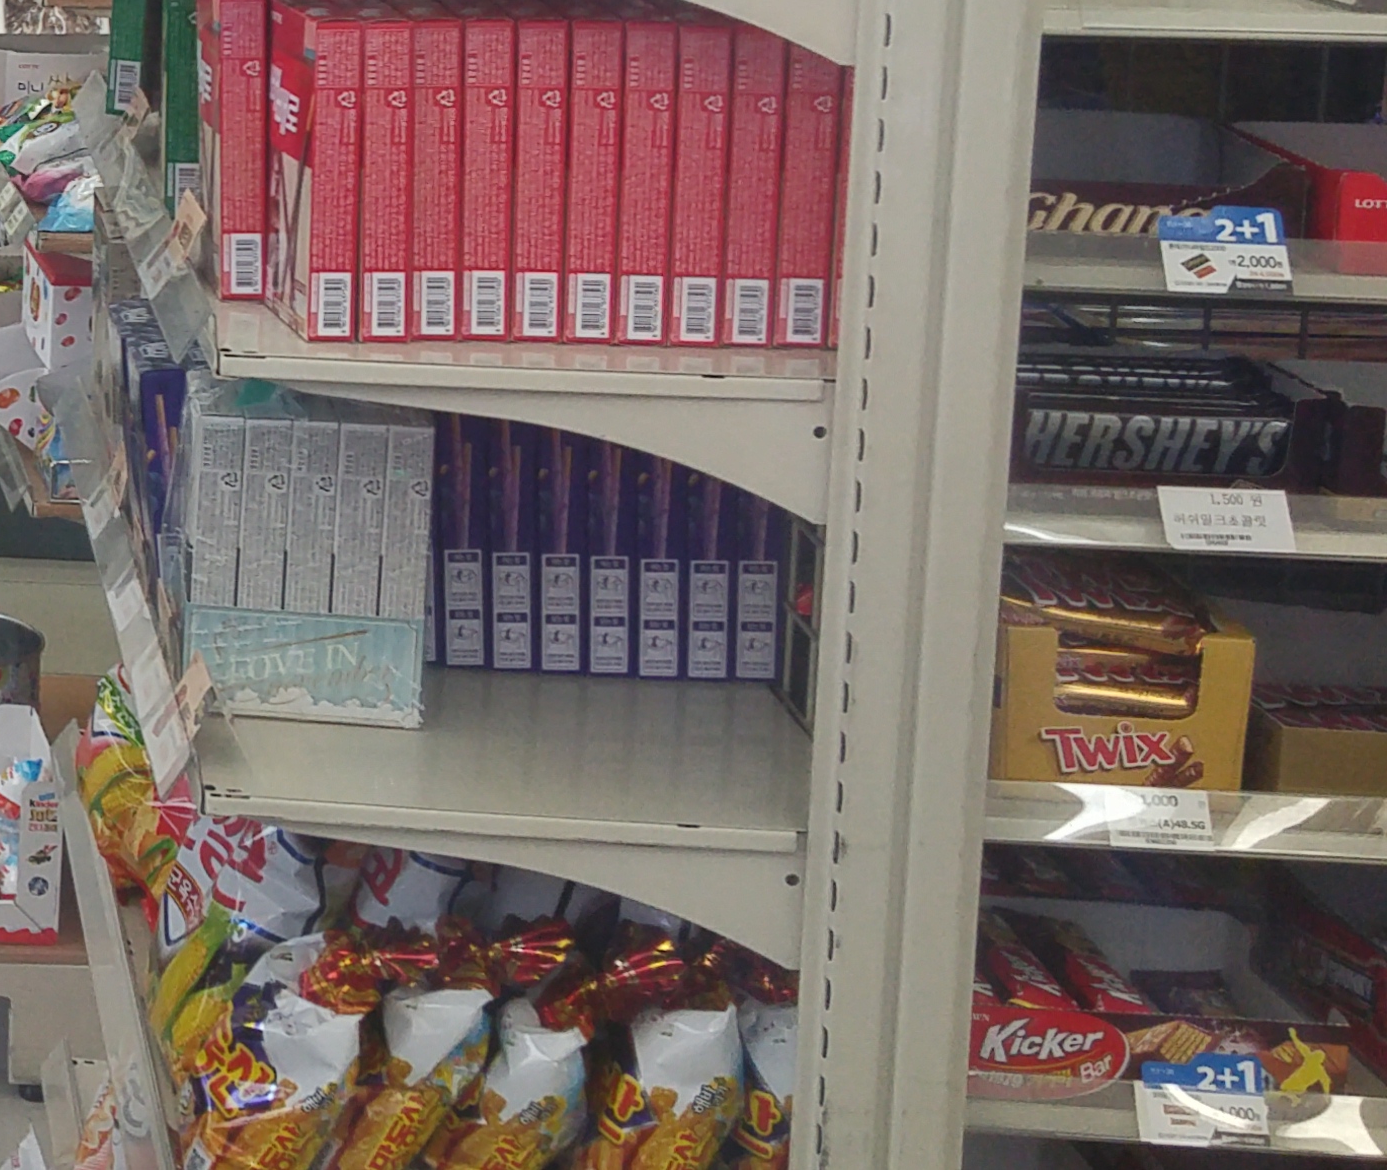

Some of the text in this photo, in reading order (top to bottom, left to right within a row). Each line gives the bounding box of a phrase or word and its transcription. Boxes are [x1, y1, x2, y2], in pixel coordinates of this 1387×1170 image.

[17, 80, 45, 93] 미니
[1029, 192, 1211, 234] Ghan
[1214, 212, 1278, 244] 2+1
[1027, 408, 1291, 475] HERSHEY'S
[1041, 721, 1177, 773] Twix
[979, 1017, 1104, 1062] Kicker
[1079, 1053, 1113, 1085] Bar
[1197, 1060, 1258, 1094] 2+1
